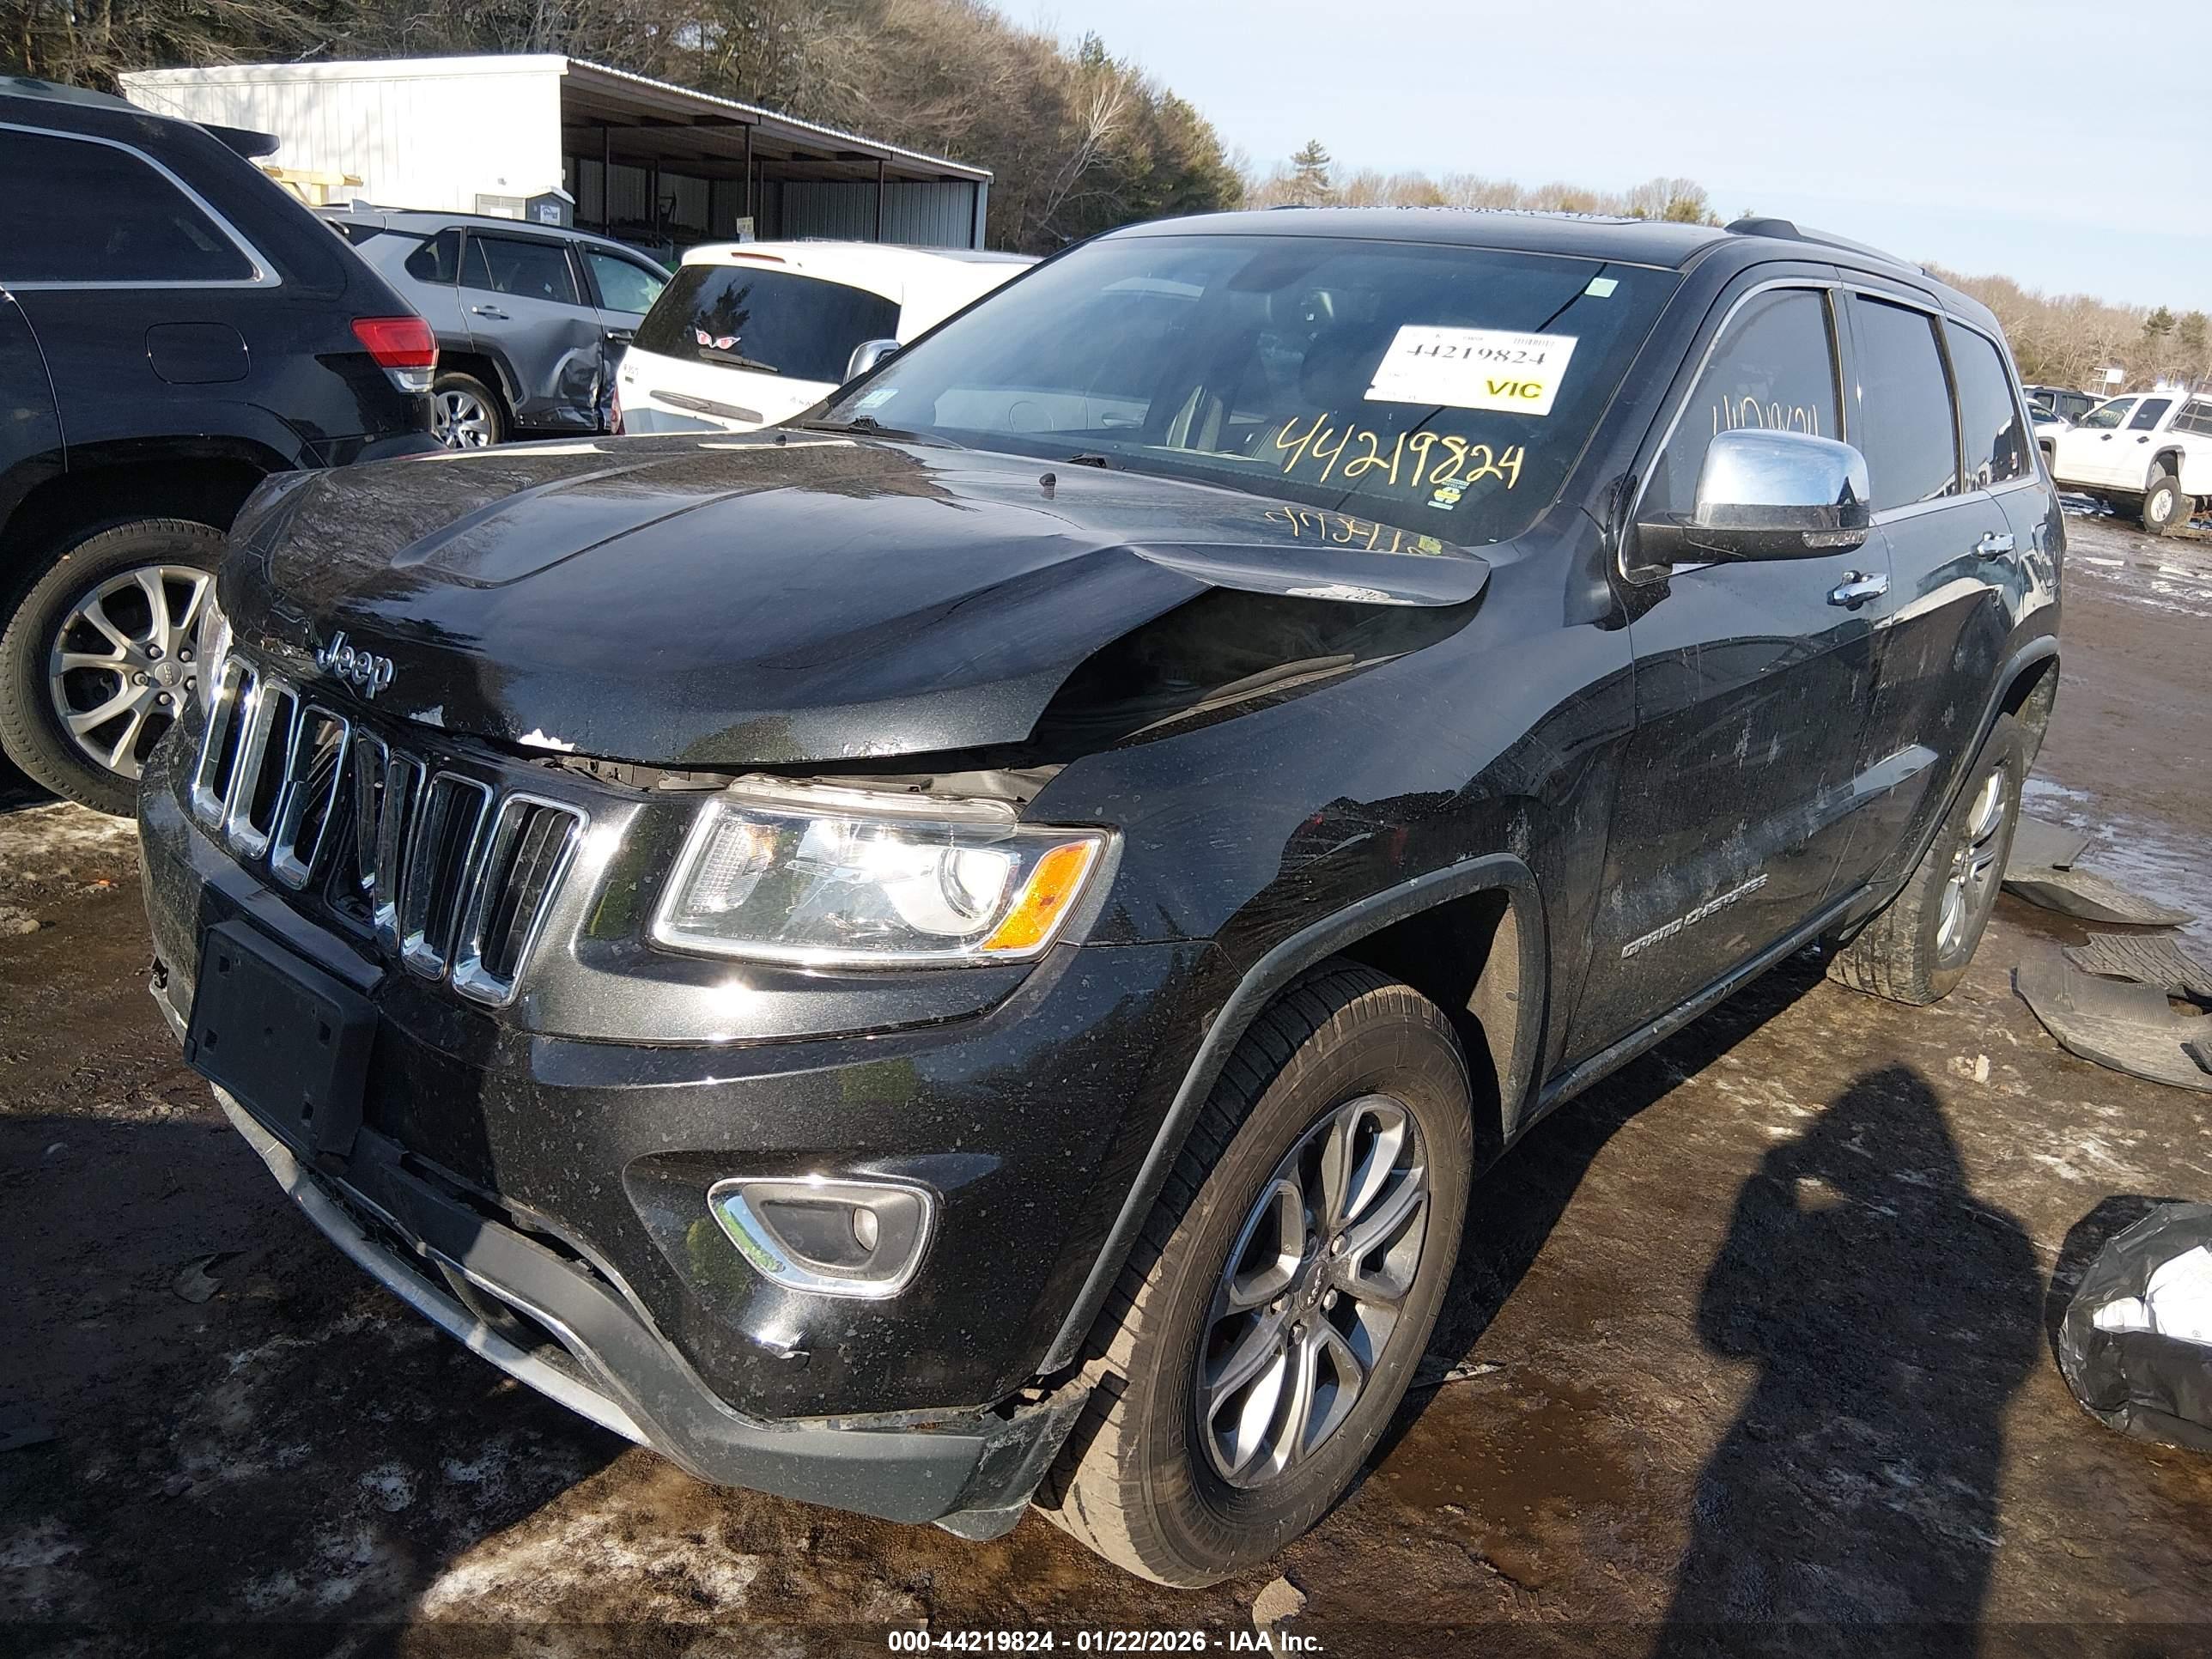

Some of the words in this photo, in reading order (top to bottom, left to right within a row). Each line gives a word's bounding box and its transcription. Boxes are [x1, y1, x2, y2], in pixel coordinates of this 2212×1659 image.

[1406, 343, 1546, 366] 44219824
[1486, 380, 1543, 399] VIC
[1276, 412, 1526, 489] 44219824
[316, 630, 395, 700] Jeep
